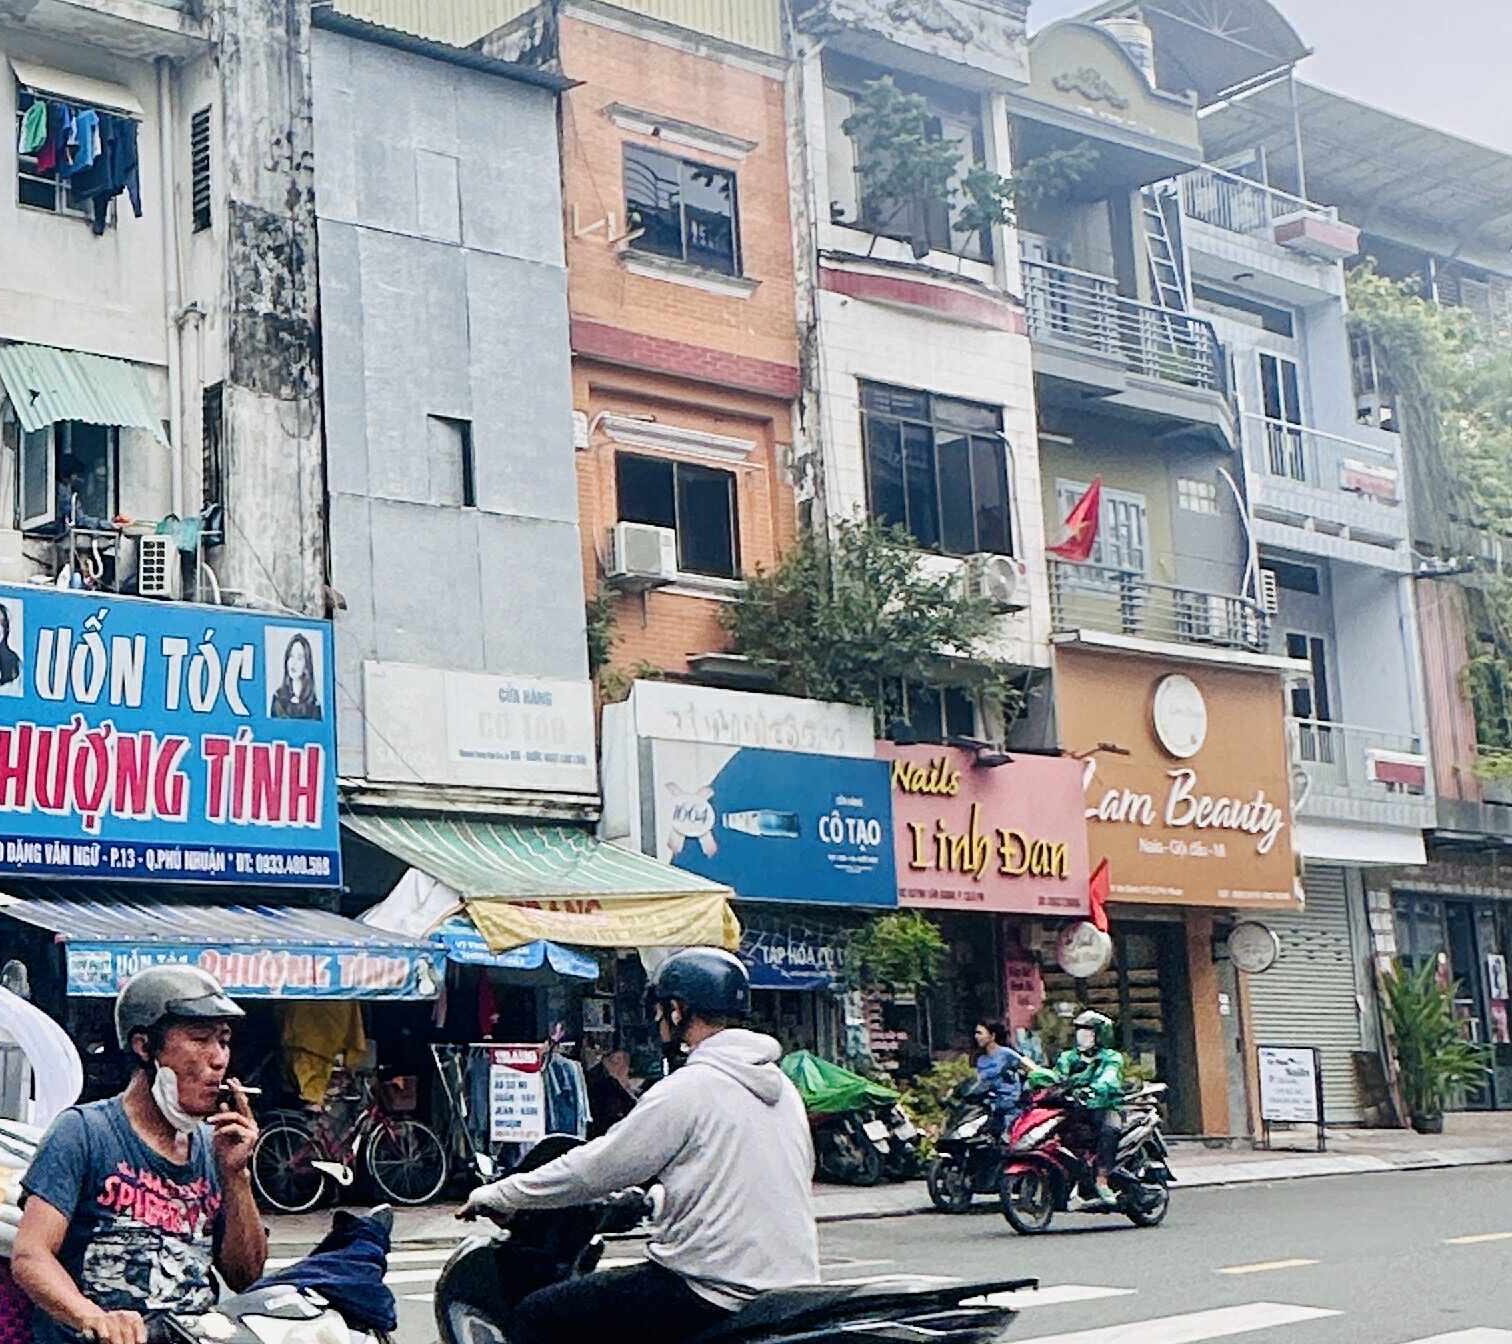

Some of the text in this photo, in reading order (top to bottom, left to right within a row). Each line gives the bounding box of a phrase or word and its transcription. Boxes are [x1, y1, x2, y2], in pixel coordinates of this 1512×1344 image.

[34, 608, 254, 716] UỐN TÓC
[202, 726, 322, 830] TÍNH
[892, 754, 962, 797] Nails
[1165, 768, 1285, 855] Beauty
[819, 809, 881, 852] CÔ TẠO
[907, 801, 992, 882] Linh
